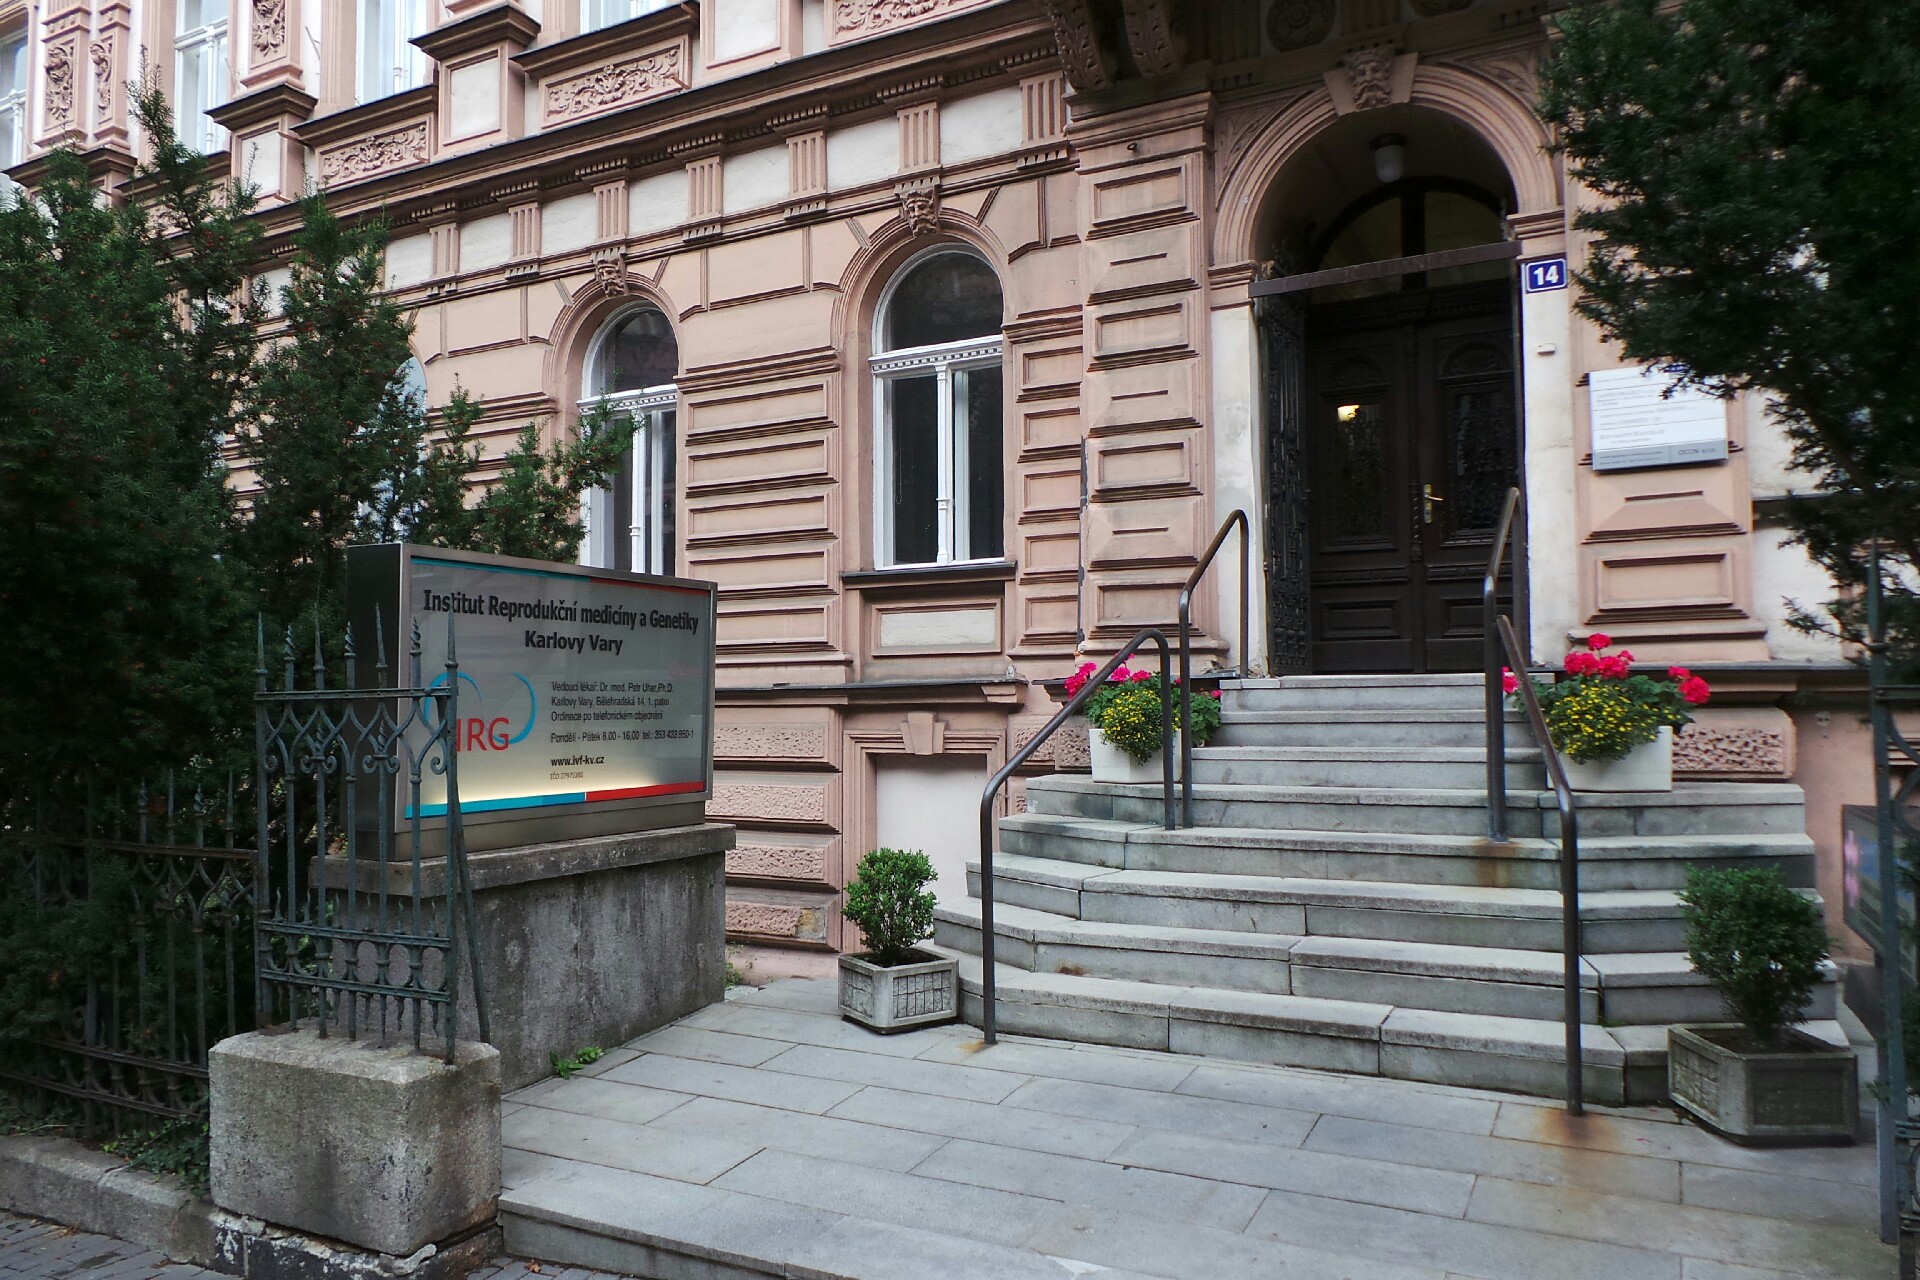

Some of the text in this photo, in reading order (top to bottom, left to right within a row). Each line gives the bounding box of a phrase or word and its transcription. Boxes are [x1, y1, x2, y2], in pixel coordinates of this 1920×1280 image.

[1533, 264, 1559, 285] 14
[424, 589, 699, 634] Institut Reprodukční medicíny a Genetiky
[525, 630, 624, 655] Karlovy Vary
[551, 681, 579, 692] Vedoucí
[600, 682, 609, 692] Dr.
[611, 682, 626, 692] med.
[628, 682, 641, 692] Petr
[551, 696, 576, 708] Karlovy
[596, 696, 635, 706] Bělehradská
[654, 698, 670, 708] patro
[551, 710, 664, 723] Ordinace po telefonickém objednání
[551, 732, 576, 743] Pondělí
[582, 731, 601, 742] Pátek
[655, 730, 666, 739] 353
[667, 729, 677, 739] 433
[551, 755, 605, 767] www.ivf-kv.cz
